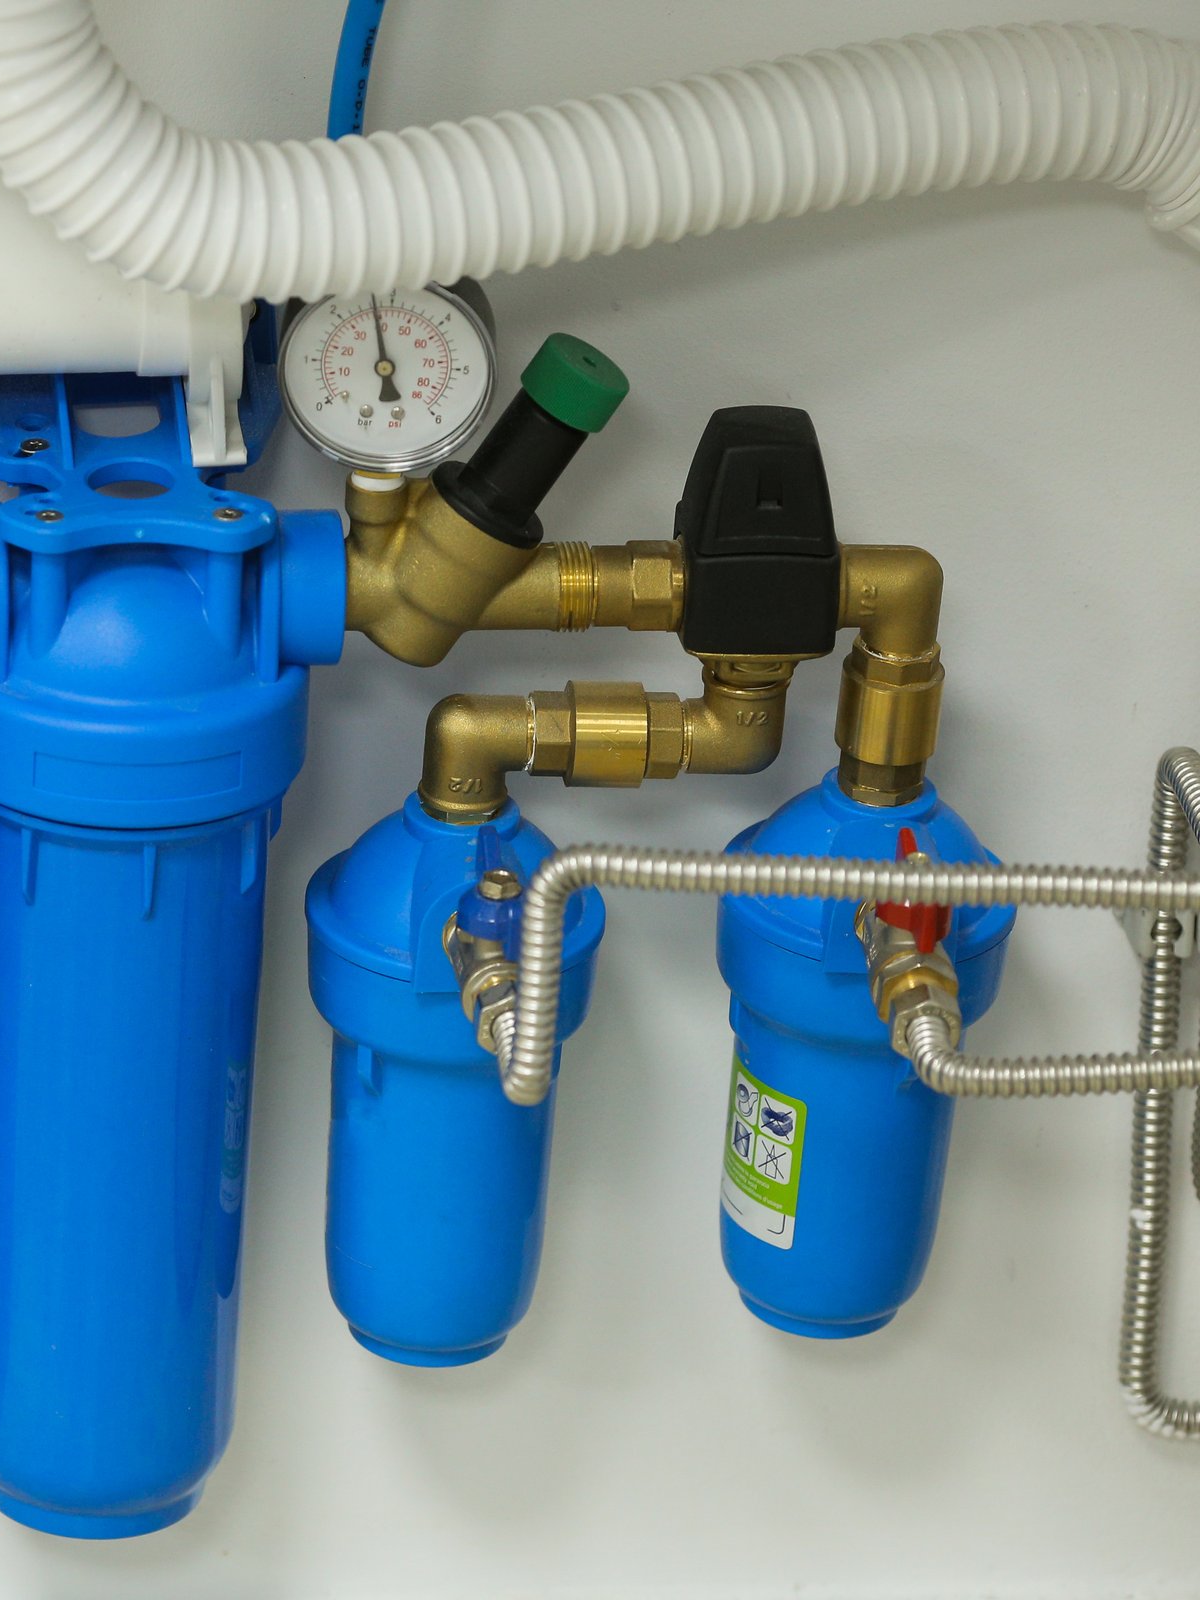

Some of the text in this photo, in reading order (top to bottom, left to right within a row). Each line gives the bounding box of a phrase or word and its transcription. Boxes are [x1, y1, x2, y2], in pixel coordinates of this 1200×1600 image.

[330, 304, 337, 314] 2
[354, 331, 367, 341] 30
[399, 326, 412, 336] 50
[414, 338, 427, 349] 60
[341, 346, 354, 357] 20
[422, 358, 435, 368] 70
[338, 367, 350, 377] 10
[462, 366, 469, 375] 5
[417, 378, 430, 388] 80
[411, 390, 423, 399] 86
[316, 402, 323, 412] 0
[357, 417, 373, 427] bar
[435, 414, 442, 424] 6
[388, 420, 402, 429] psi
[736, 710, 769, 726] 1/2
